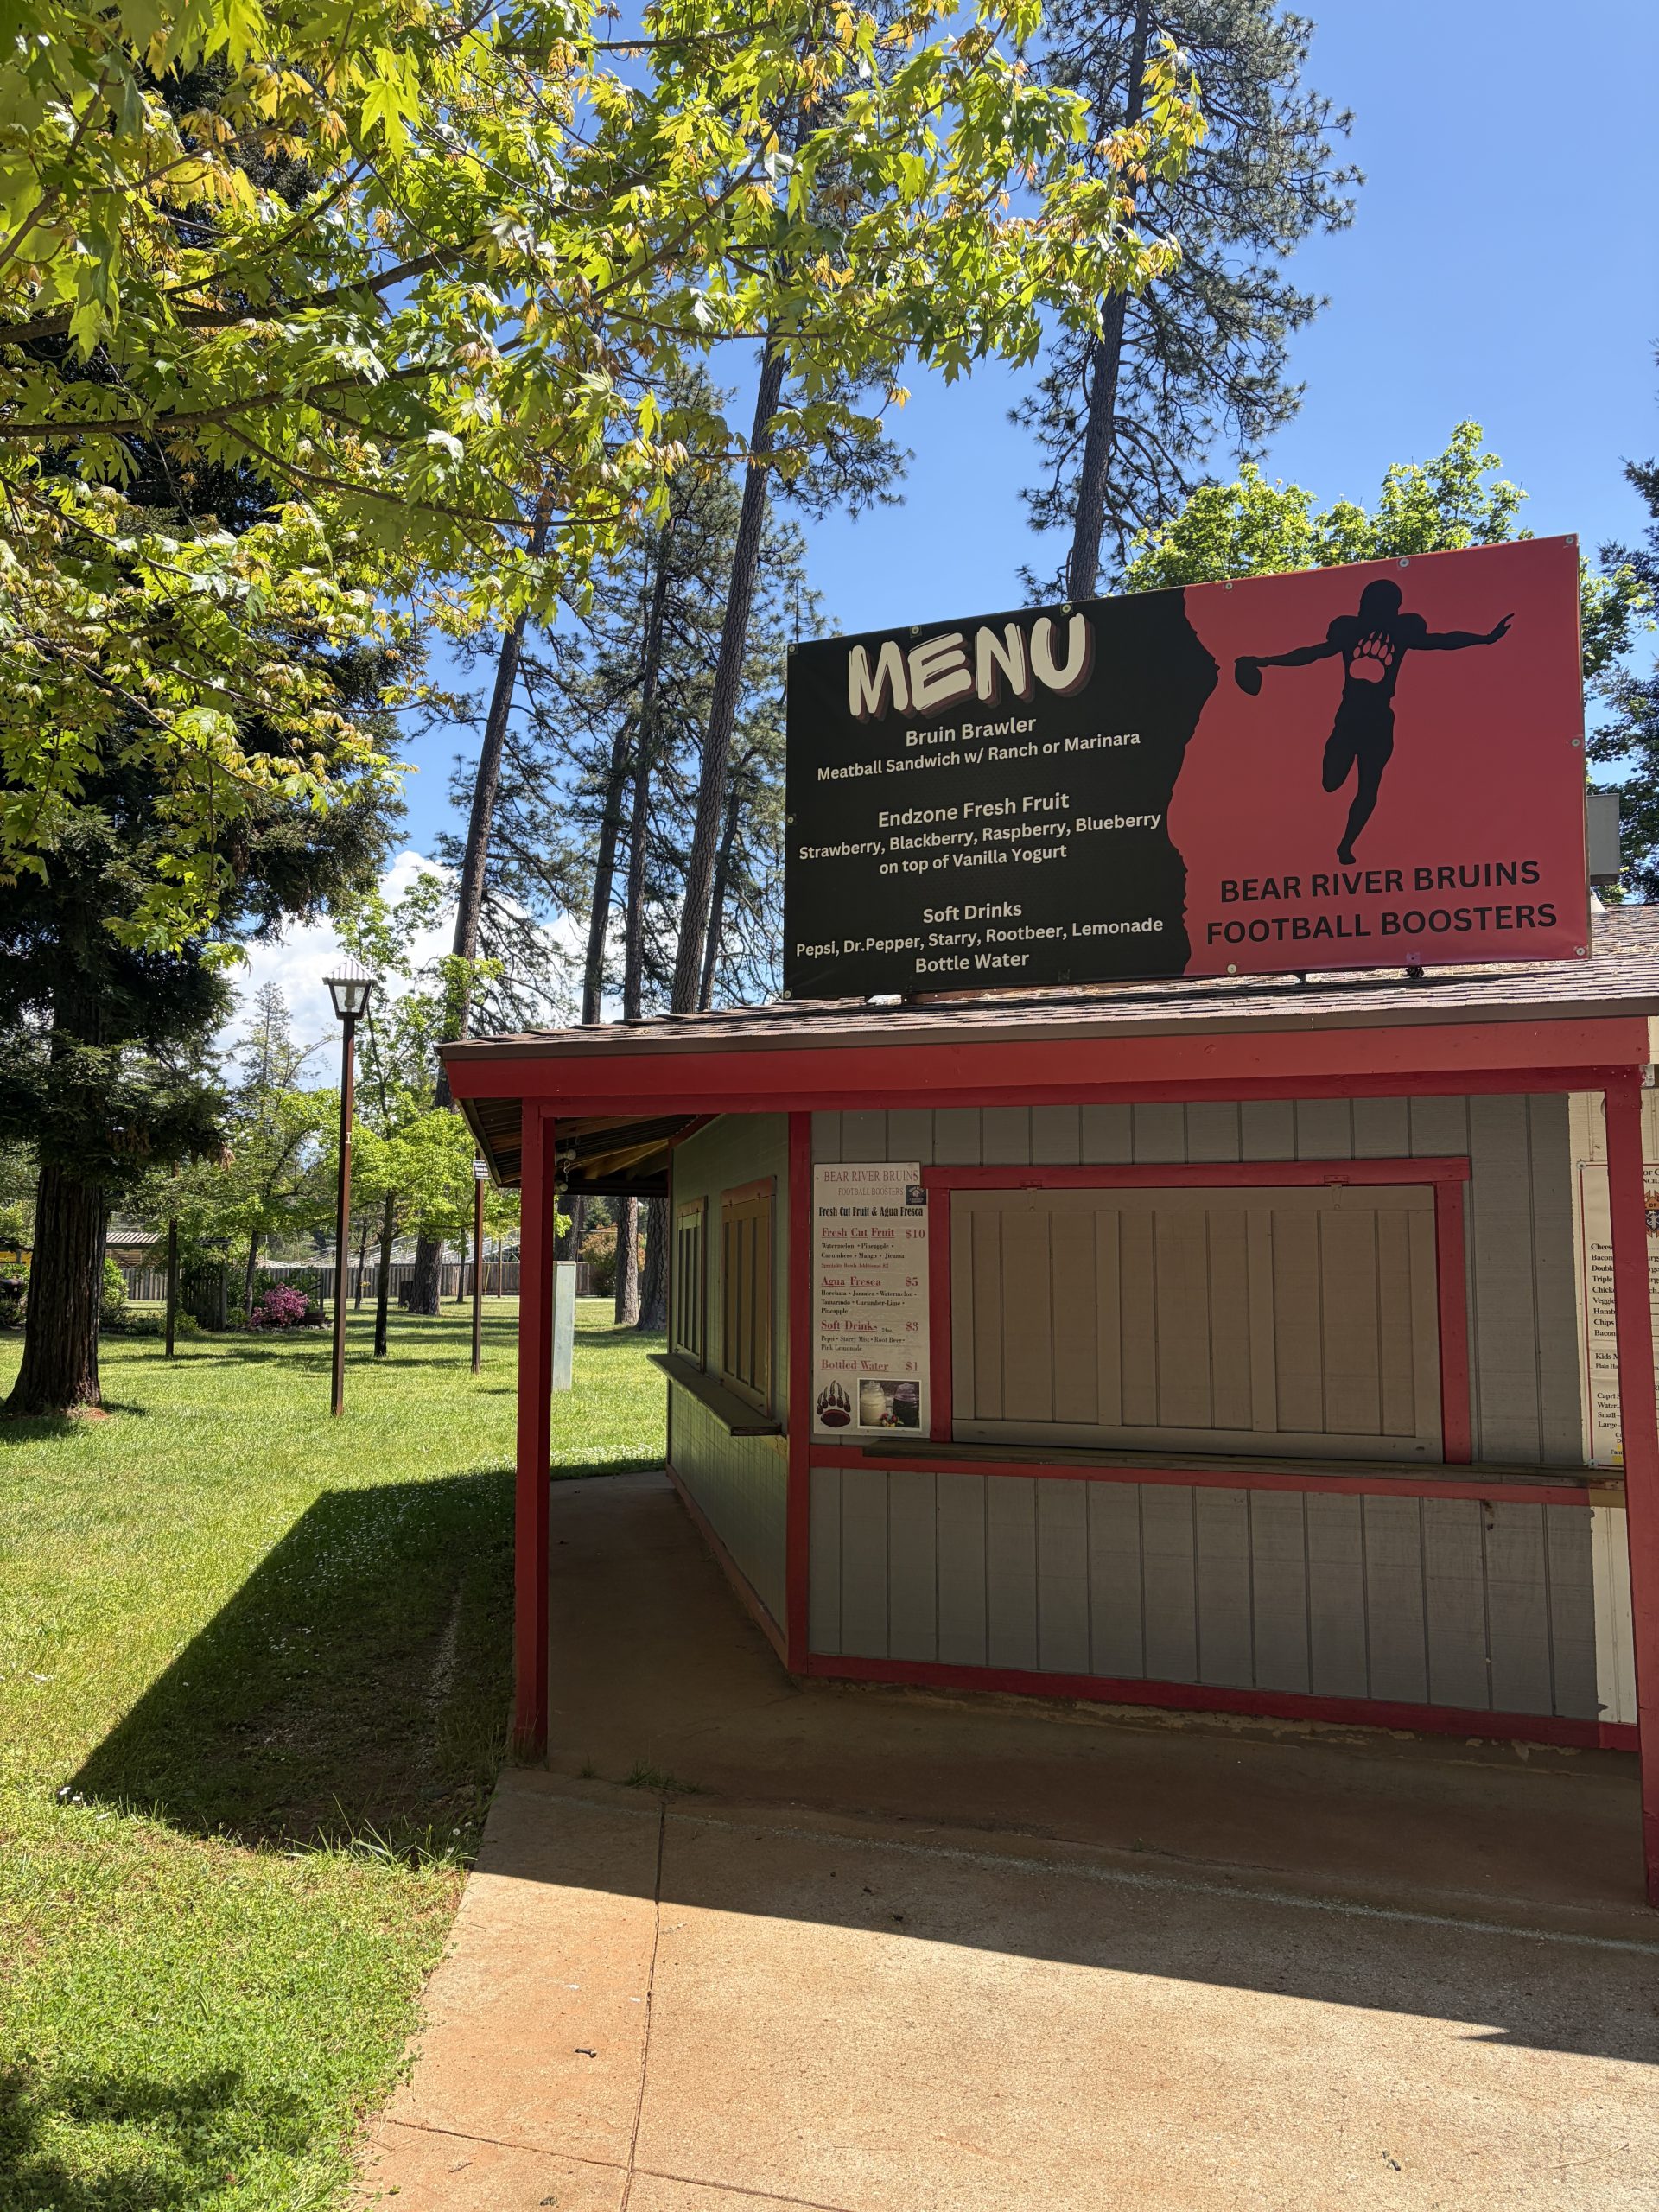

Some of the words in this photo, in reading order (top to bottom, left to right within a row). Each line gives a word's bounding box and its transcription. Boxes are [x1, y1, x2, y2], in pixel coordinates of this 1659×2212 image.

[849, 613, 1089, 717] MENU
[906, 726, 956, 747] Bruin
[962, 717, 1037, 740] Brawler
[817, 760, 883, 781] Meatball
[886, 752, 960, 772] Sandwich
[964, 747, 983, 765] w/
[988, 741, 1038, 761] Ranch
[1042, 743, 1060, 754] or
[1065, 732, 1141, 752] Marinara
[878, 807, 958, 828] Endzone
[963, 798, 1016, 818] Fresh
[1022, 792, 1070, 813] Fruit
[799, 841, 886, 860] Strawberry,
[889, 831, 978, 851] Blackberry,
[982, 823, 1071, 842] Raspberry,
[1076, 814, 1161, 833] Blueberry
[879, 862, 899, 874] on
[902, 859, 929, 874] top
[932, 854, 950, 869] of
[952, 849, 1007, 867] Vanilla
[1012, 844, 1068, 863] Yogurt
[1221, 876, 1301, 903] BEAR
[1311, 869, 1404, 897] RIVER
[1414, 860, 1540, 891] BRUINS
[923, 906, 960, 924] Soft
[964, 901, 1022, 920] Drinks
[1207, 913, 1372, 944] FOOTBALL
[1382, 903, 1557, 935] BOOSTERS
[796, 940, 840, 958] Pepsi,
[928, 931, 982, 948] Starry,
[986, 925, 1067, 943] Rootbeer,
[1072, 917, 1163, 937] Lemonade
[915, 954, 969, 973] Bottle
[974, 952, 1030, 969] Water
[824, 1171, 849, 1182] BEAR
[851, 1170, 880, 1182] RIVER
[883, 1169, 918, 1182] BRUINS
[871, 1187, 904, 1196] BOOSTERS
[818, 1207, 837, 1217] Fresh
[840, 1207, 851, 1217] Cut
[852, 1207, 869, 1217] Fruit
[871, 1207, 877, 1216] &
[880, 1207, 898, 1217] Agua
[899, 1207, 924, 1217] Fresca
[822, 1228, 847, 1237] Fresh
[850, 1228, 868, 1237] Cut
[871, 1228, 895, 1237] Fruit
[905, 1229, 925, 1239] $10
[822, 1276, 845, 1287] Agua
[850, 1276, 881, 1286] Fresca
[906, 1276, 918, 1287] $5
[821, 1319, 840, 1330] Soft
[845, 1320, 878, 1331] Drinks
[906, 1321, 918, 1332] $3
[821, 1359, 857, 1370] Bottled
[860, 1360, 889, 1370] Water
[906, 1361, 918, 1371] $1
